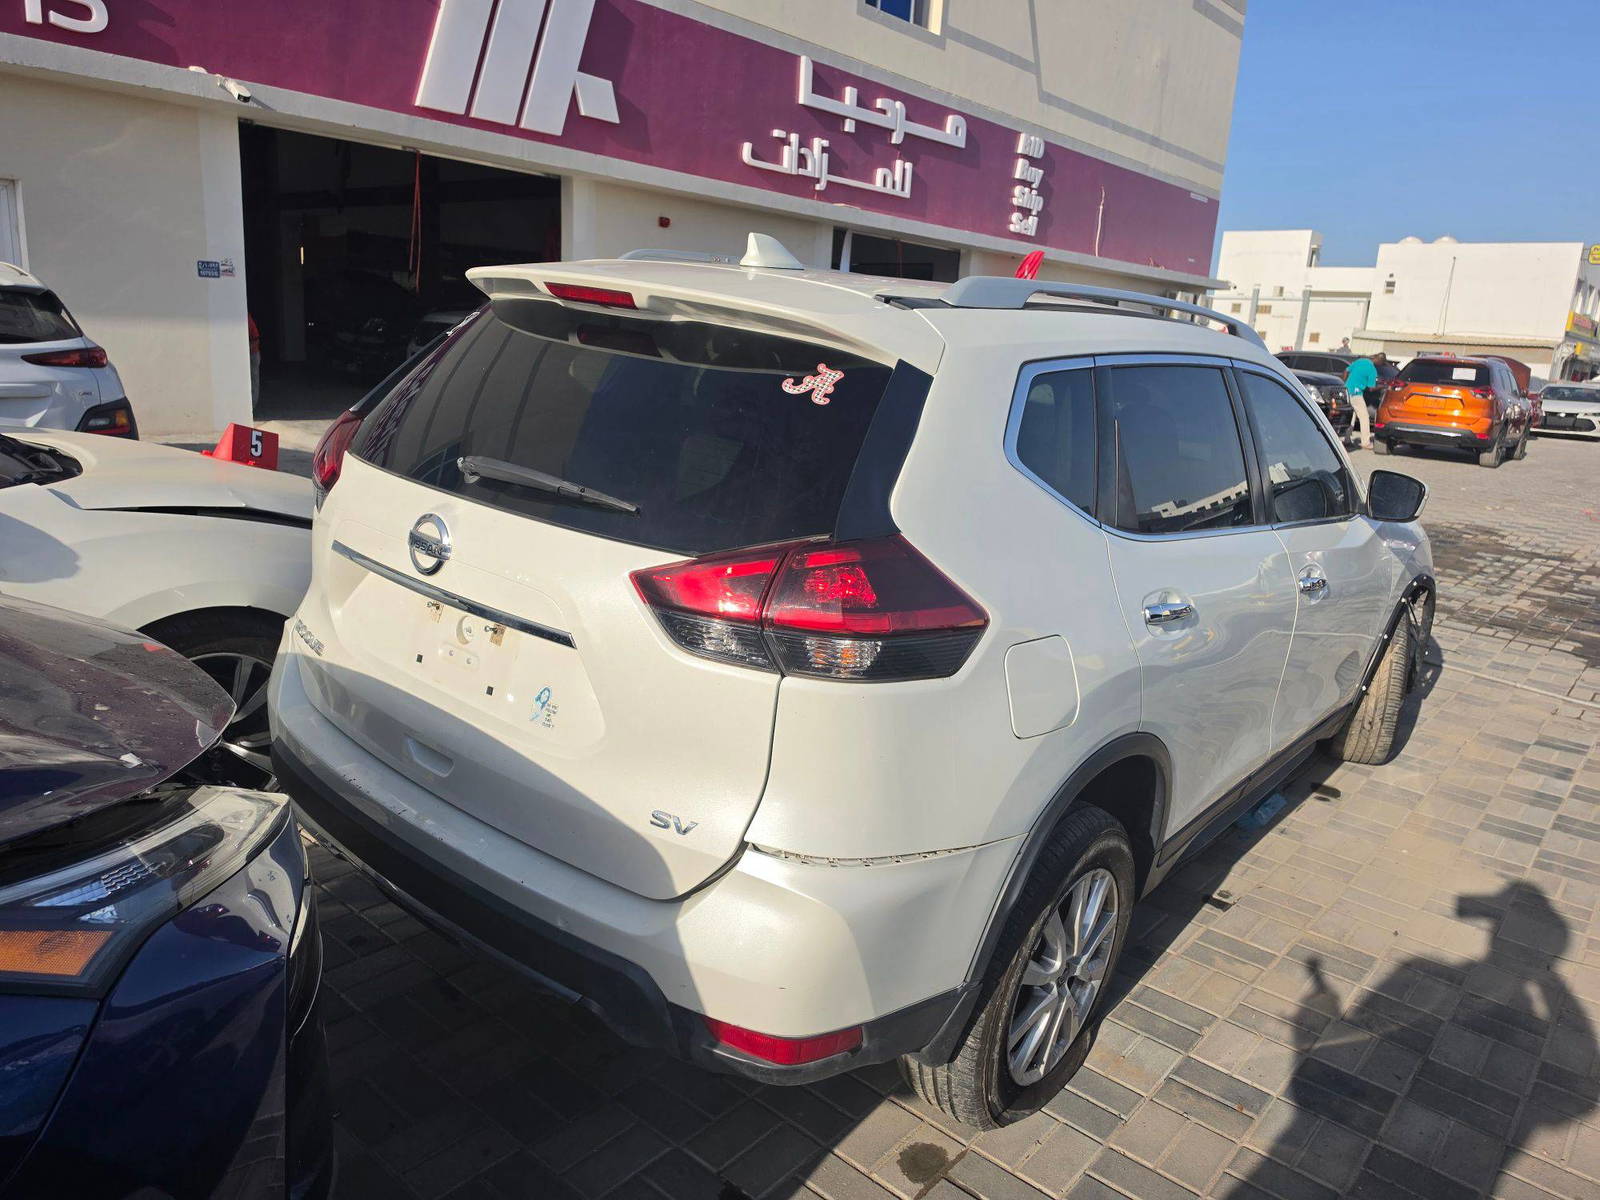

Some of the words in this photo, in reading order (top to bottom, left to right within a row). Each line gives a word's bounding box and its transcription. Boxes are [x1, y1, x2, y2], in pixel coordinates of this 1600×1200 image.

[798, 55, 967, 148] مرحبا
[741, 129, 912, 199] للمزادات
[1014, 158, 1044, 189] Buy
[1012, 185, 1044, 216] Ship
[1008, 212, 1039, 237] Sell
[250, 429, 263, 458] 5
[649, 809, 699, 836] SV
